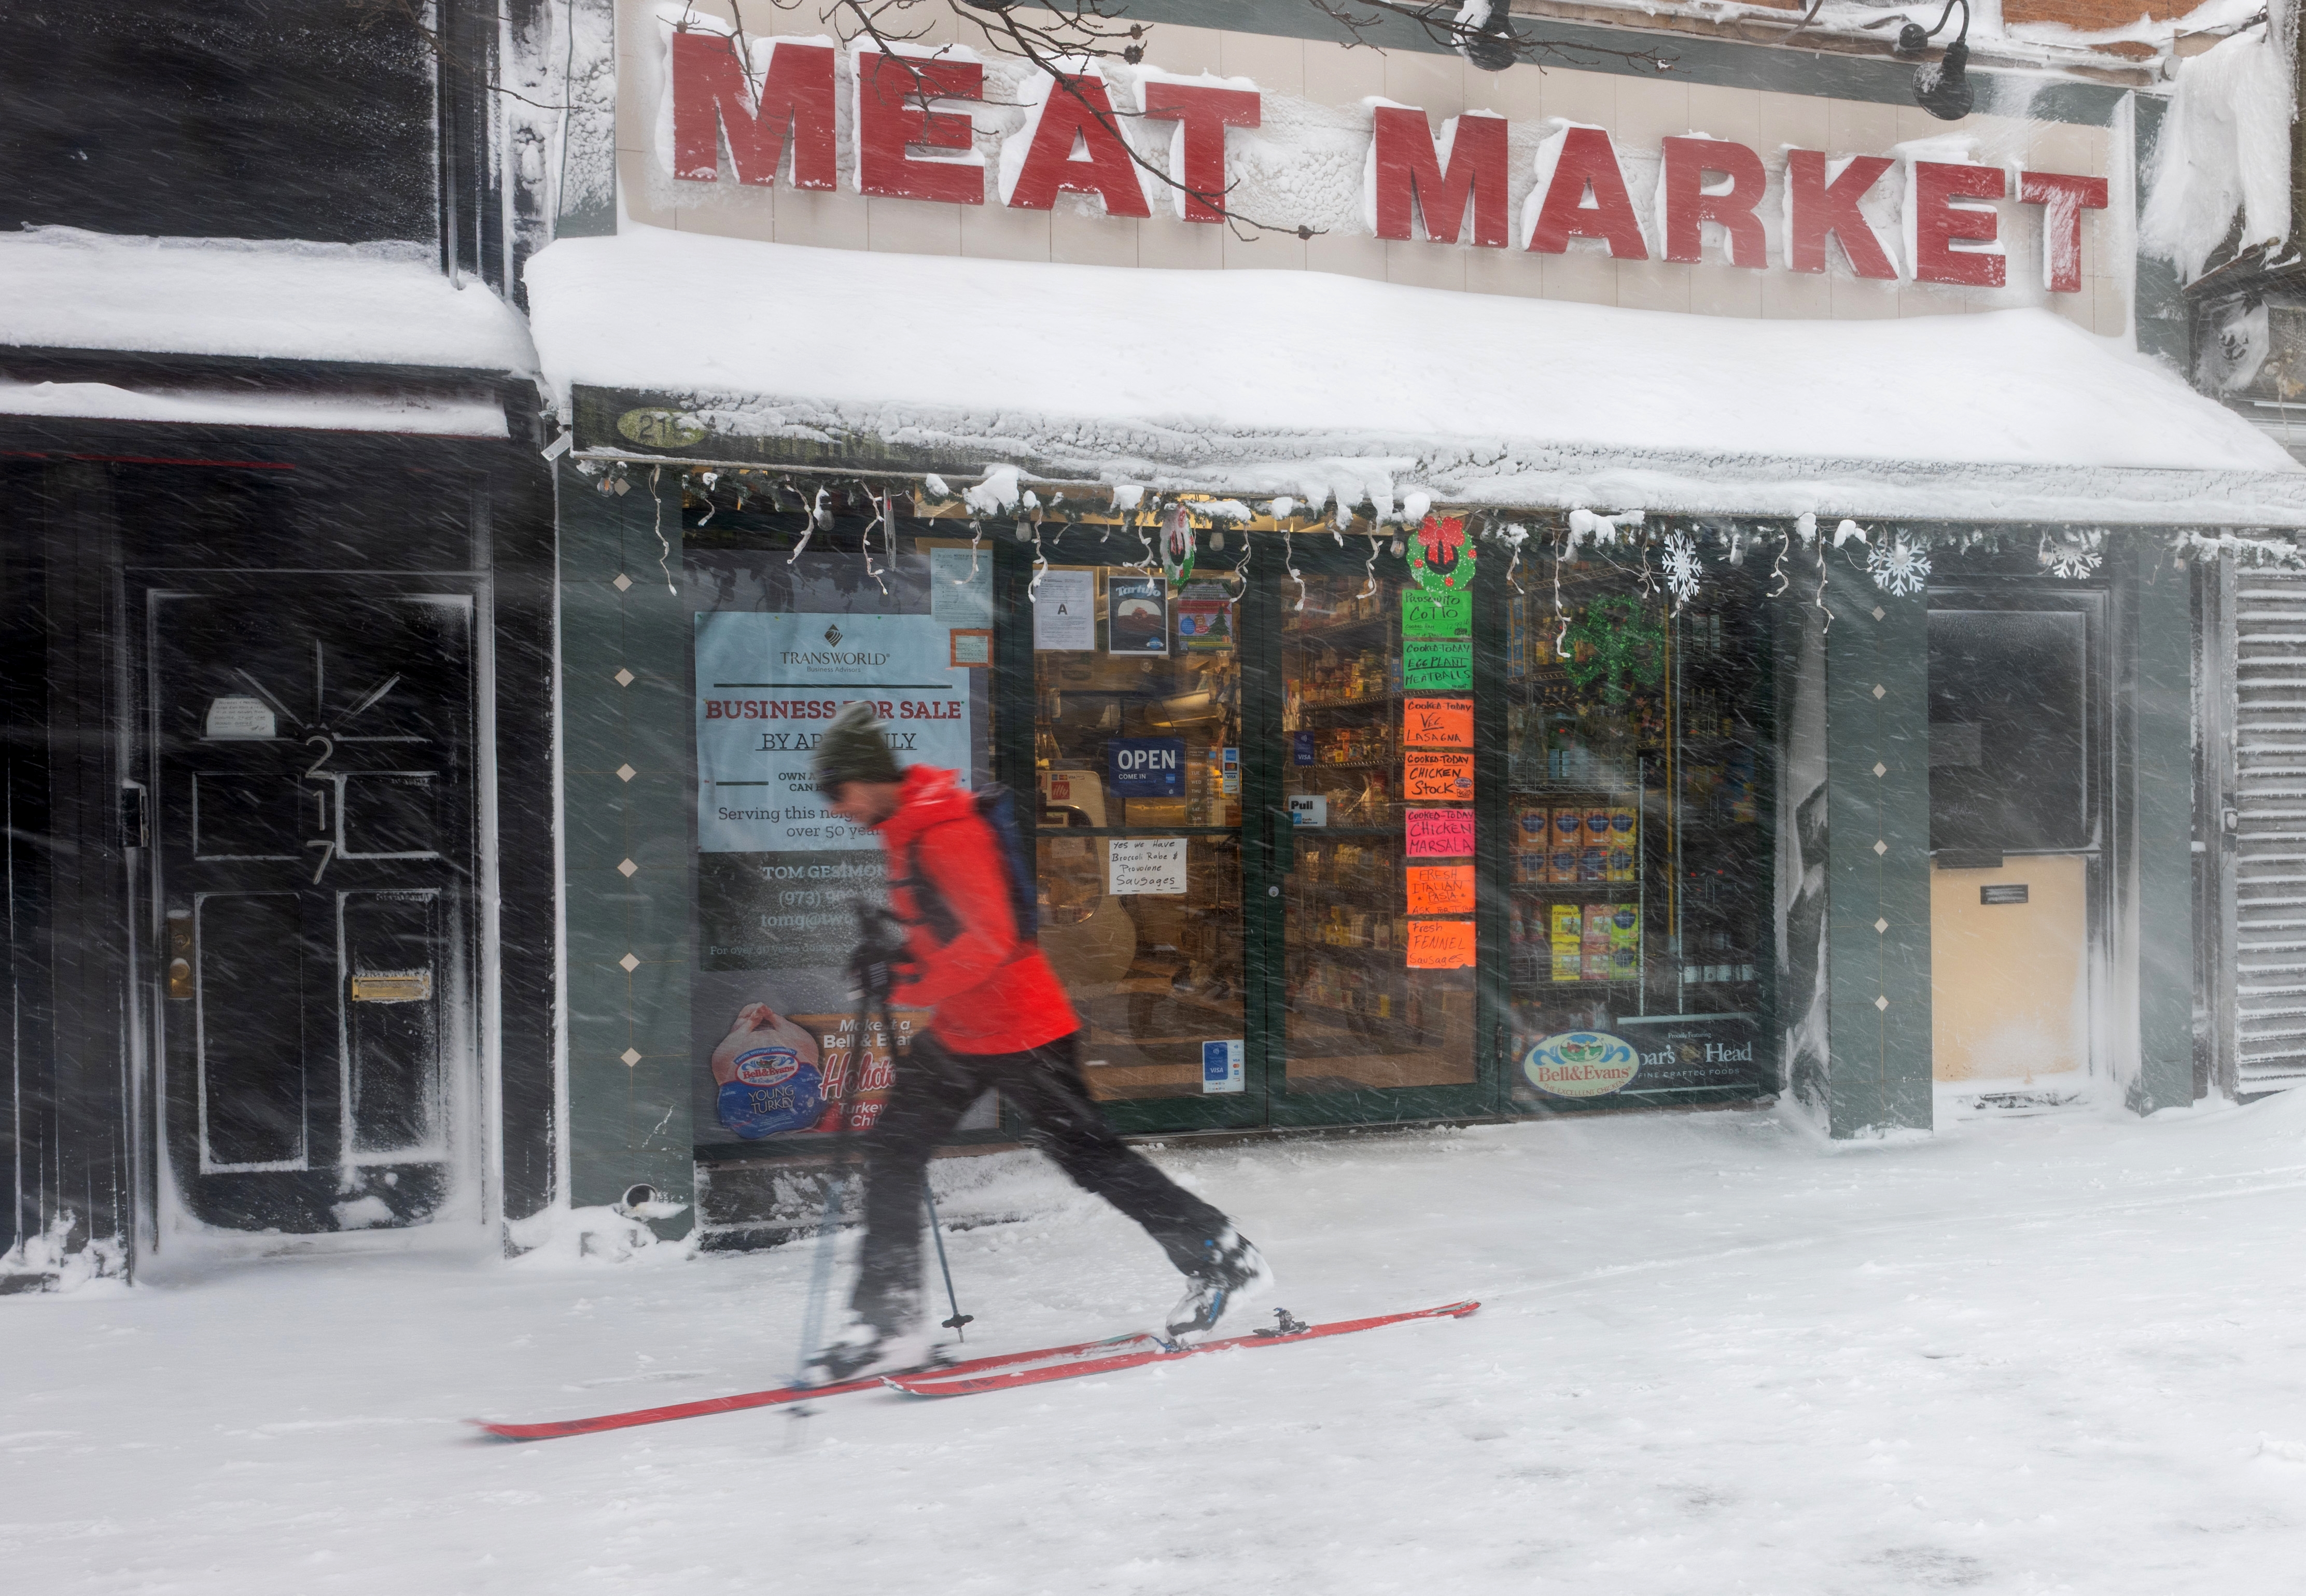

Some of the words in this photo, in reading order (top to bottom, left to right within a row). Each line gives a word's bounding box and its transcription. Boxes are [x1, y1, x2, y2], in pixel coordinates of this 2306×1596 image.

[673, 32, 1261, 223] MEAT
[1373, 105, 2108, 293] MARKET
[1116, 585, 1161, 597] Tartufo
[1057, 603, 1068, 615] A
[1405, 670, 1471, 686] MEATBALLS
[705, 701, 836, 719] BUSINESS
[900, 701, 961, 719] SALE
[762, 733, 790, 749] BY
[1406, 730, 1461, 743] LASAGNA
[1118, 750, 1176, 769] OPEN
[1410, 768, 1461, 779] CHICKEN
[1053, 785, 1068, 797] illy
[1291, 801, 1313, 809] Pull
[719, 807, 780, 823] Serving
[785, 806, 815, 819] this
[787, 828, 821, 837] over
[826, 826, 844, 838] 50
[1410, 822, 1472, 837] CHICKEN
[1409, 839, 1473, 855] MARSALA
[1112, 853, 1143, 862] Broccoli
[1147, 852, 1168, 861] Rabe
[1172, 851, 1178, 861] &
[762, 866, 804, 879] TOM
[1119, 864, 1162, 874] Provolone
[1419, 869, 1457, 880] FRESH
[1116, 875, 1176, 887] Sausages
[1412, 881, 1463, 894] ITALIAN
[779, 891, 821, 907] (973)
[1428, 889, 1456, 902] PASTA
[1413, 906, 1430, 914] ASK
[1413, 922, 1443, 933] Fresh
[1414, 935, 1466, 950] FENNEL
[710, 946, 729, 955] For
[1410, 953, 1464, 967] Sausages
[900, 1020, 910, 1030] a
[823, 1034, 855, 1048] Bell
[859, 1034, 872, 1047] &
[736, 1053, 750, 1063] RAISED
[1705, 1041, 1753, 1063] Head
[743, 1066, 794, 1080] Bell&Evans
[748, 1085, 794, 1102] YOUNG
[1543, 1083, 1556, 1092] THE
[1557, 1087, 1595, 1096] EXCELLENT
[1596, 1080, 1625, 1095] CHICKEN
[751, 1096, 795, 1114] TURKEY
